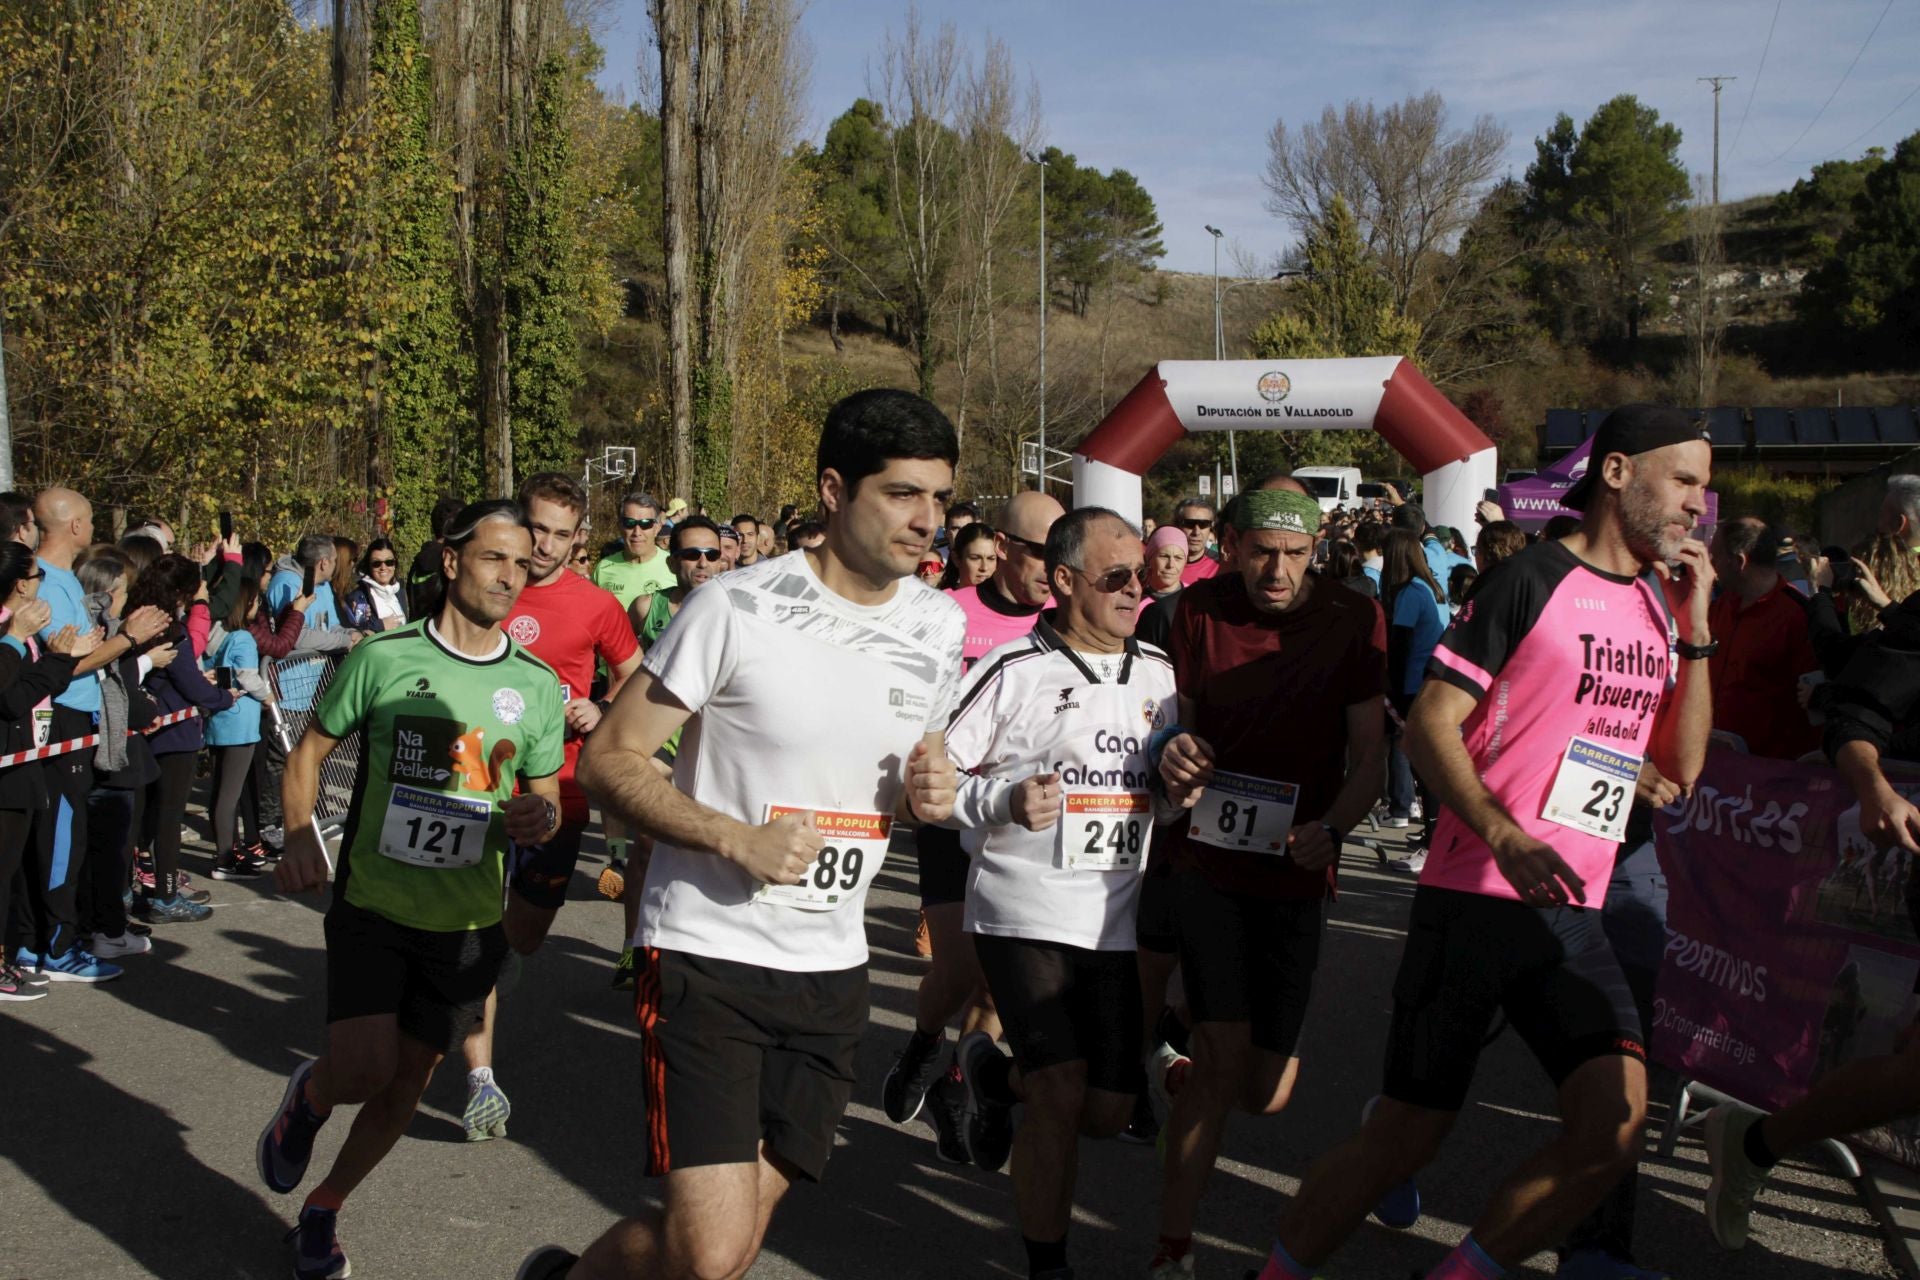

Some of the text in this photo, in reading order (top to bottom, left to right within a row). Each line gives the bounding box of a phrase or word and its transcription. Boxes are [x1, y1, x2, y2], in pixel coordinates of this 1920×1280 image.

[1197, 405, 1354, 417] DIPUTACIÓN DE VALLADOLID
[1579, 634, 1665, 681] Triatlón
[406, 690, 437, 699] VIATOR
[1574, 672, 1660, 721] Pisuerga
[398, 730, 424, 747] Na
[396, 744, 427, 762] tur
[1573, 744, 1621, 766] CARRERA
[393, 761, 434, 781] Pellet
[396, 790, 487, 814] CARRERA POPULAR
[1069, 797, 1117, 806] CARRERA
[1581, 779, 1625, 822] 23
[835, 816, 887, 830] POPULAR
[1218, 800, 1258, 837] 81
[406, 816, 466, 857] 121
[837, 829, 870, 838] VALCORBA
[1083, 820, 1140, 854] 248
[794, 846, 864, 891] 89
[1664, 1007, 1757, 1066] Cronometraje
